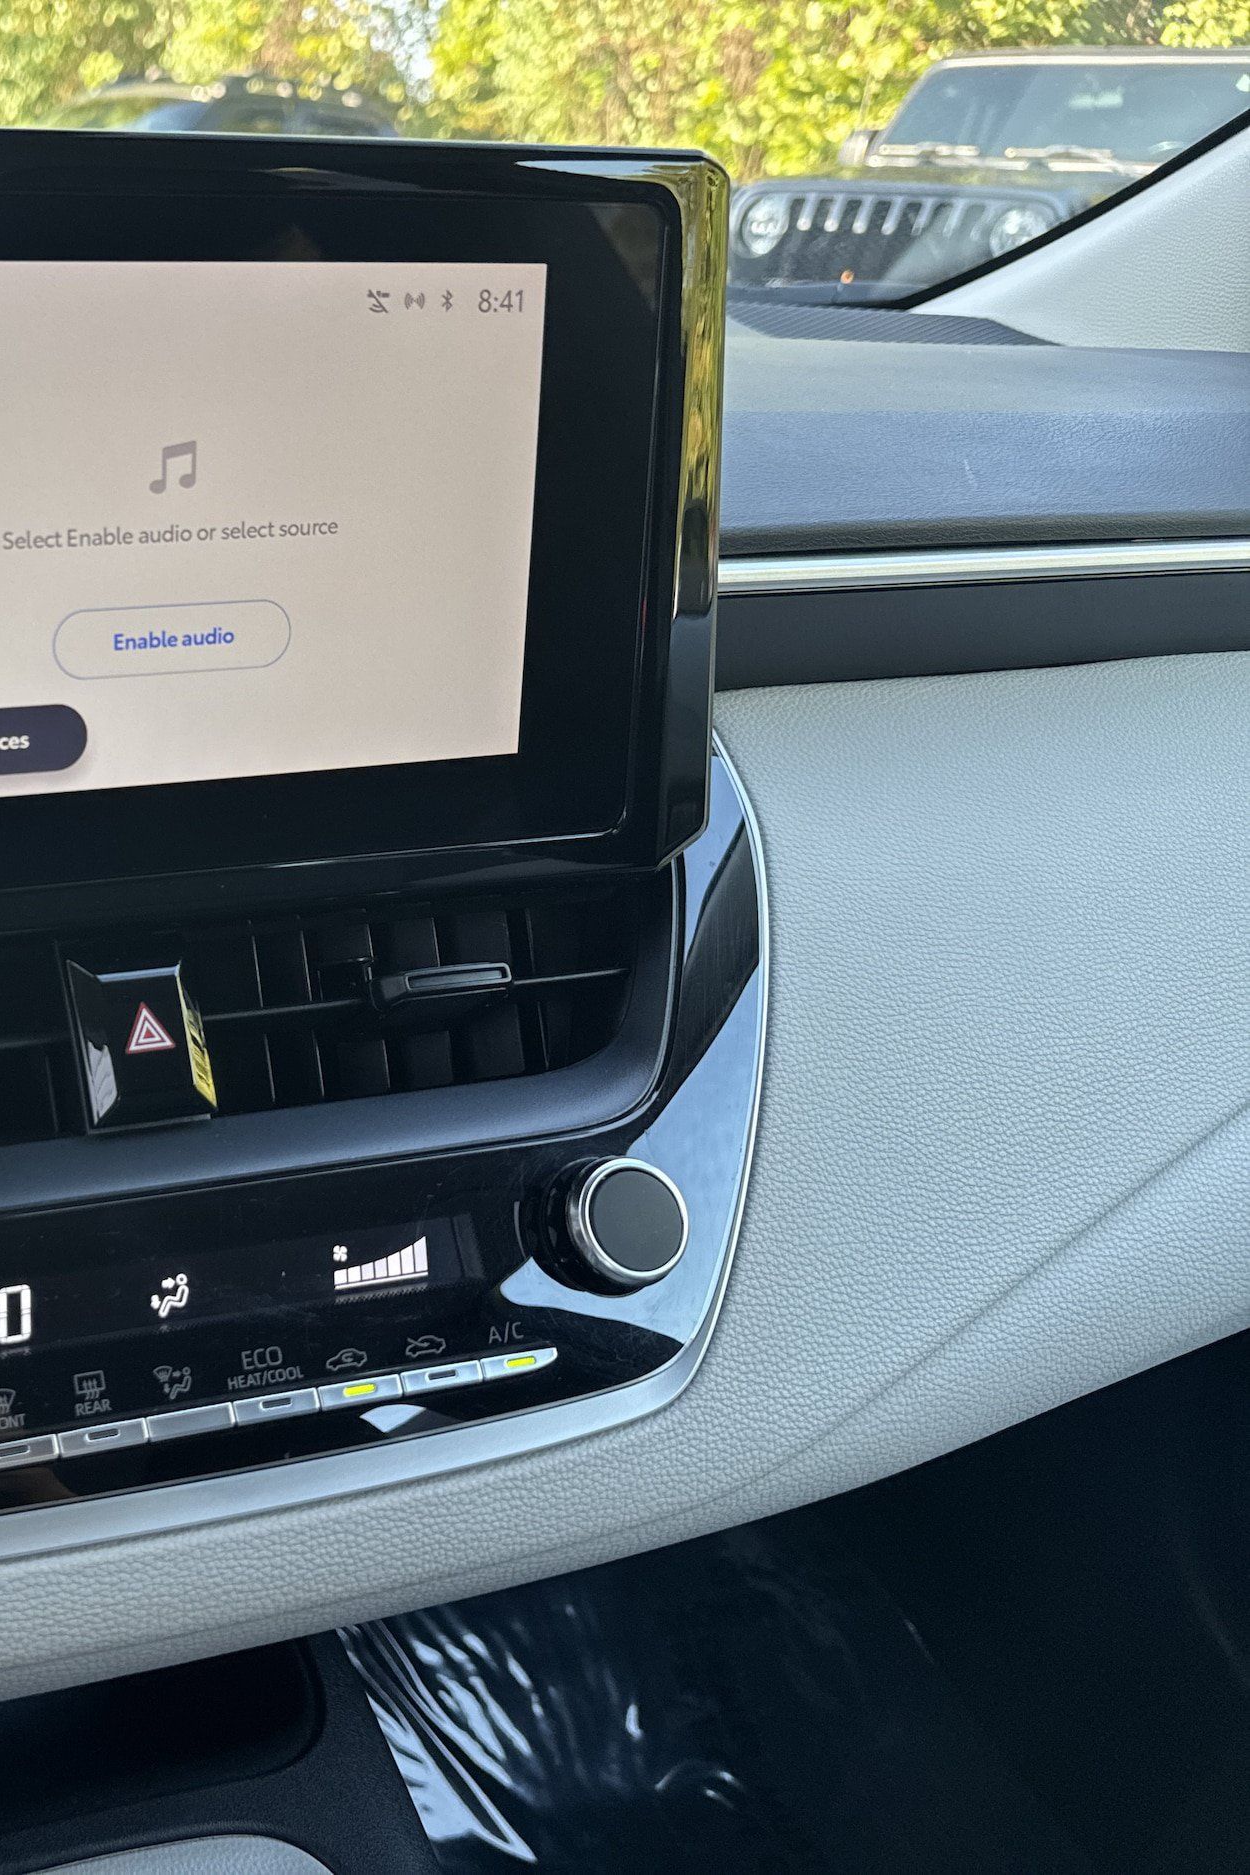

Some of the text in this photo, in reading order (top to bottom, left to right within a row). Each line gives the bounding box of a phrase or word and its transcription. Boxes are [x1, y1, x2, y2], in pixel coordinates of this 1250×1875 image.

[477, 288, 525, 313] 8:41
[2, 520, 339, 550] Select Enable audio or select source
[113, 626, 235, 651] Enable audio
[488, 1321, 524, 1344] A/C
[240, 1346, 283, 1371] ECO
[227, 1365, 305, 1391] HEAT/COOL
[74, 1398, 113, 1417] REAR
